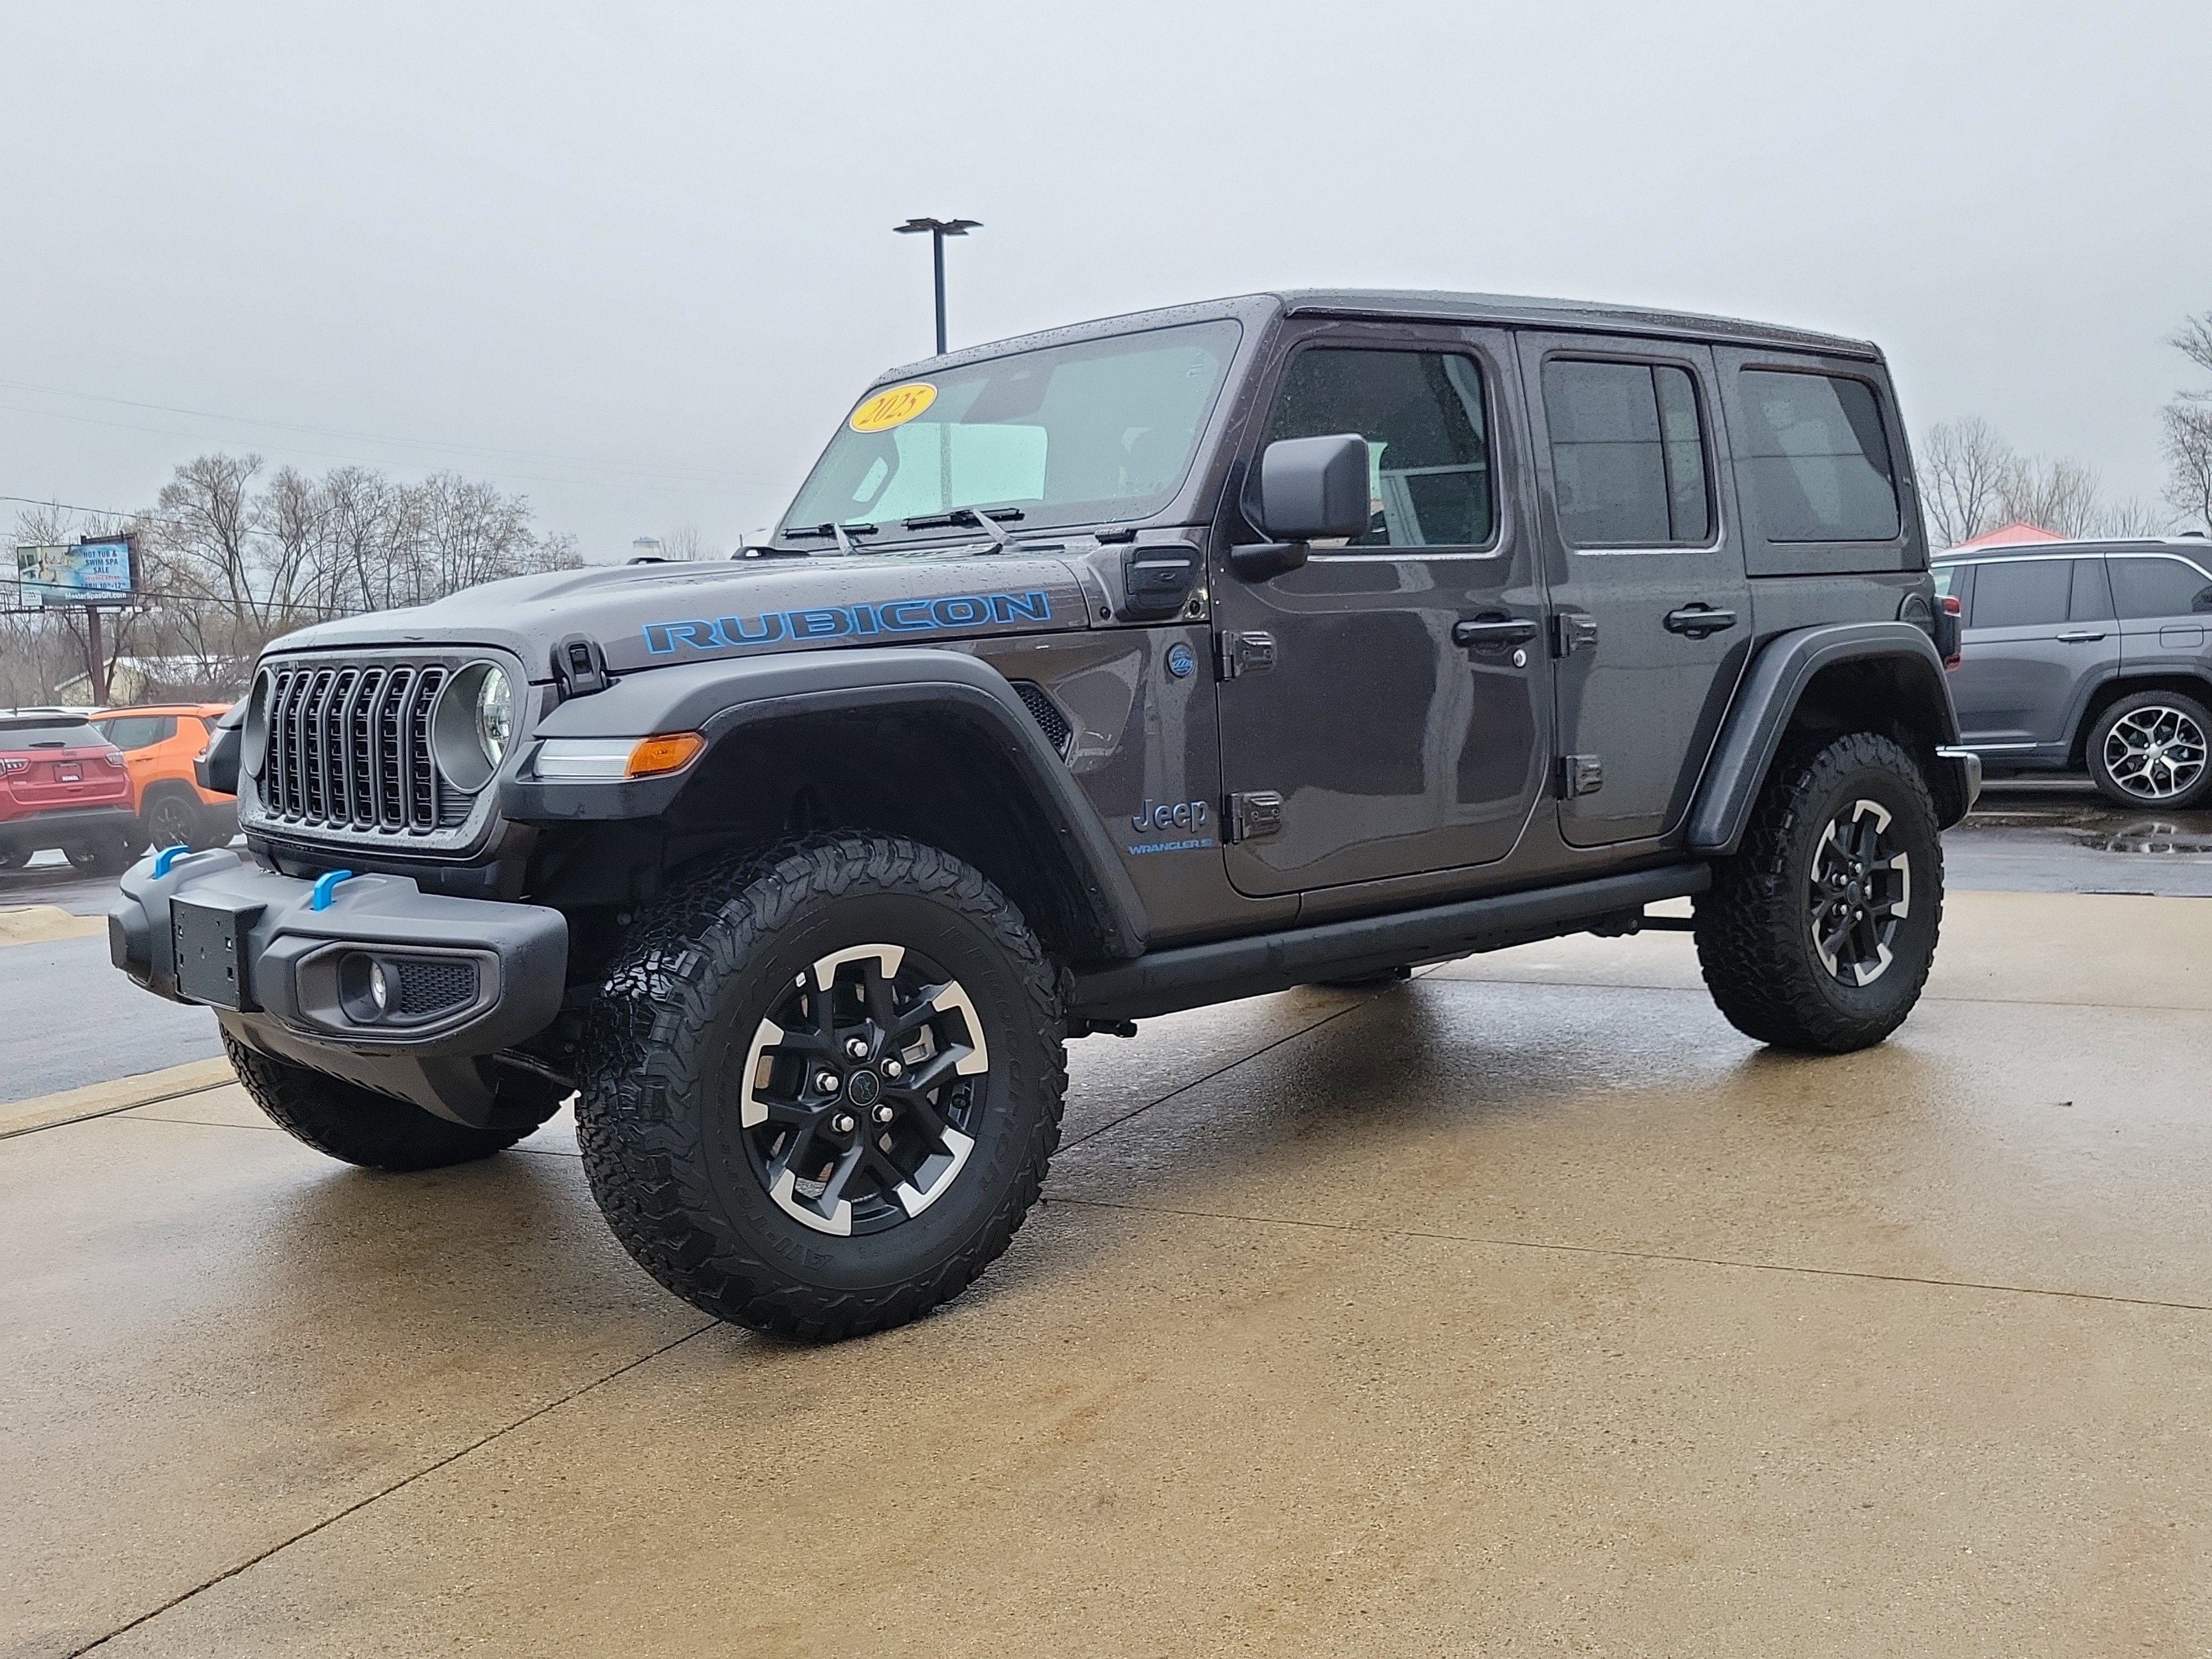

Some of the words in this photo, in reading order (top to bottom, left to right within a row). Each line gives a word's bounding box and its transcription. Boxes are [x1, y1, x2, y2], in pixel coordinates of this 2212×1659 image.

[859, 390, 927, 425] 2025
[641, 591, 1052, 654] RUBICON
[1132, 798, 1208, 833] Jeep
[1128, 839, 1200, 855] WRANGLER
